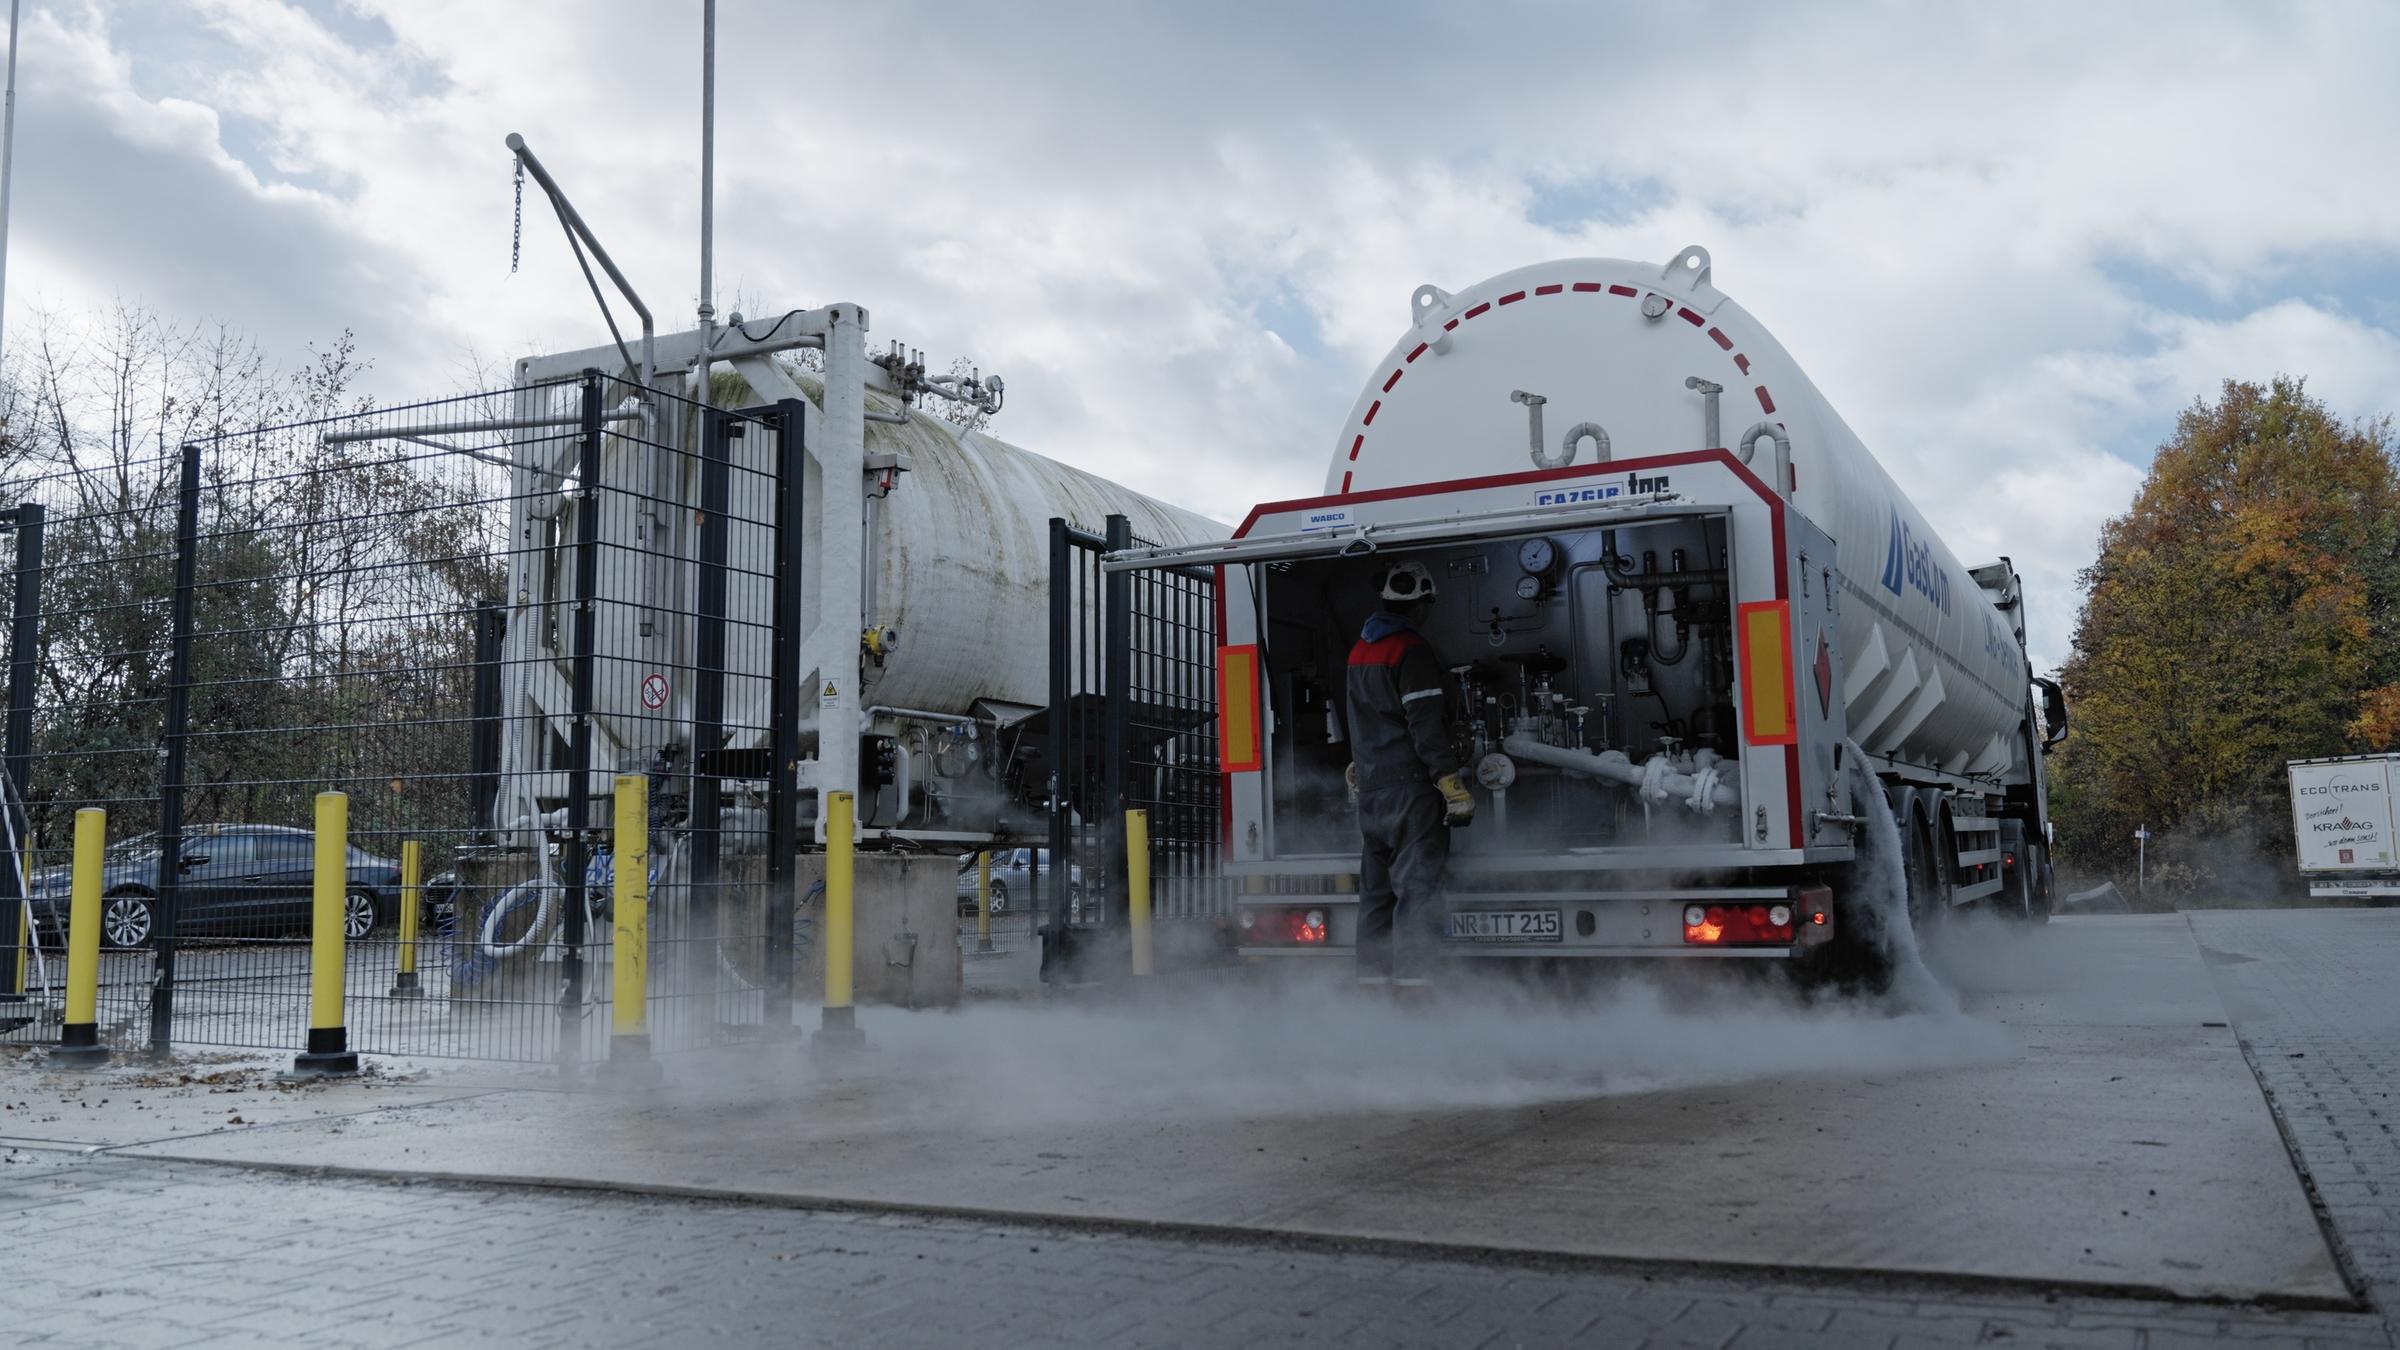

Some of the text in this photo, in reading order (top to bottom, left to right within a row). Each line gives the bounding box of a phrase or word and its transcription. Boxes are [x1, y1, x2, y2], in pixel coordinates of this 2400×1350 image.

[1311, 513, 1345, 523] WABCO
[1903, 519, 1951, 617] GasCom
[2300, 783, 2380, 796] ECO TRANS
[2313, 817, 2373, 832] KRAVAG
[1452, 913, 1558, 934] NR TT 215
